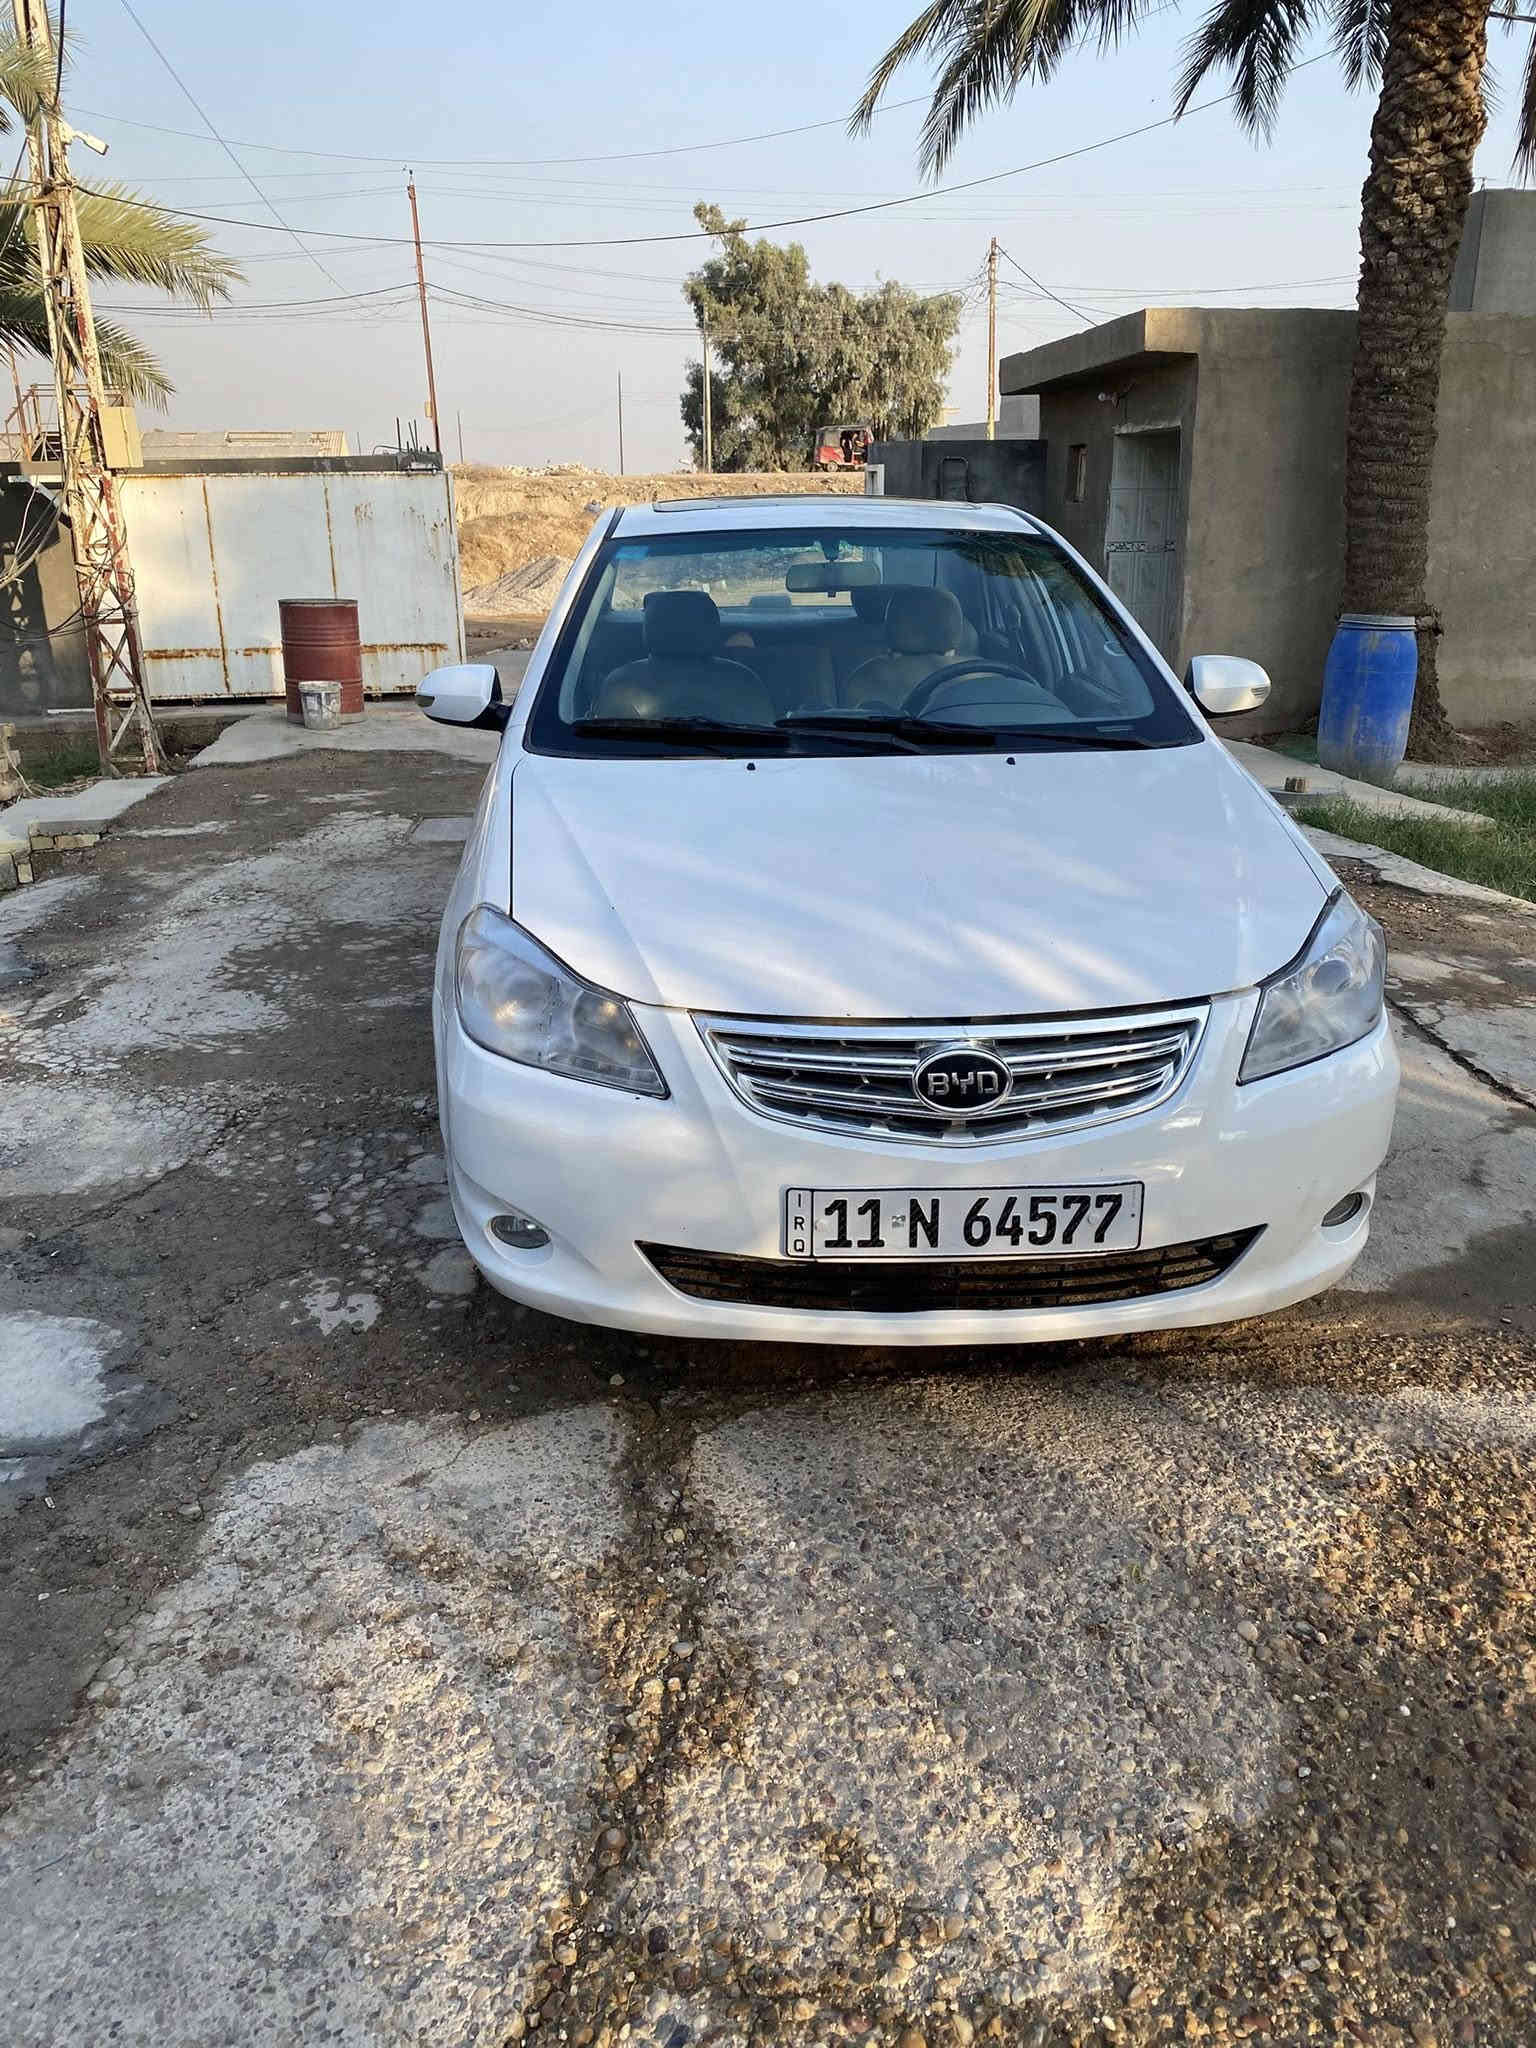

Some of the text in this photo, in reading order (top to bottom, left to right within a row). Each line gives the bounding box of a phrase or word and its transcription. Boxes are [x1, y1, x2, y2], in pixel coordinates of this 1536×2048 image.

[927, 1070, 999, 1096] BYD
[793, 1193, 805, 1253] IRQ
[824, 1199, 885, 1248] 11
[909, 1198, 940, 1248] N
[963, 1193, 1123, 1248] 64577
